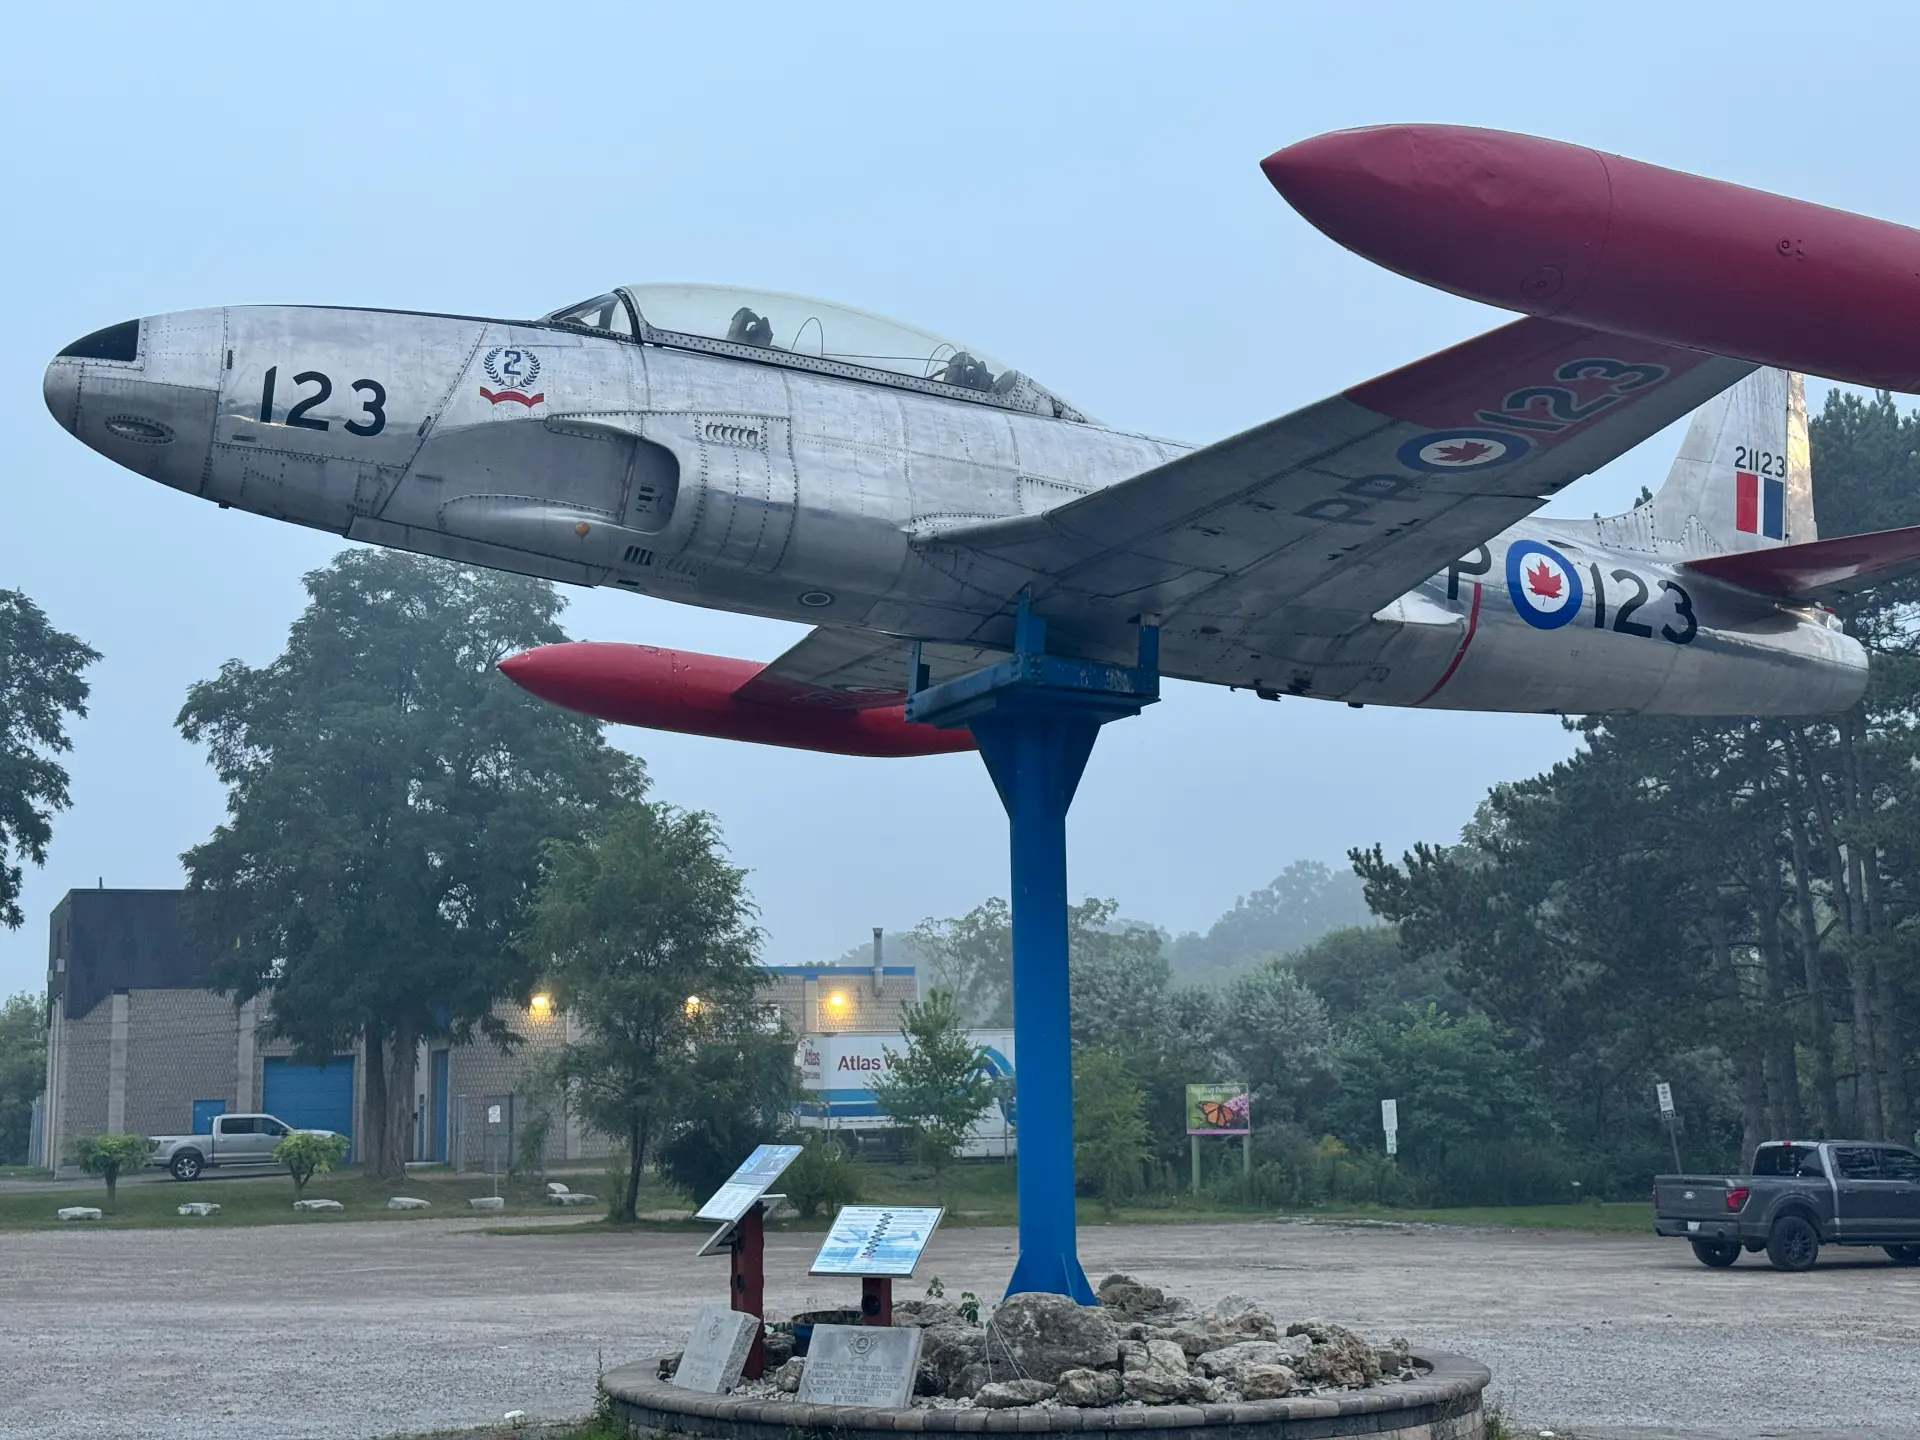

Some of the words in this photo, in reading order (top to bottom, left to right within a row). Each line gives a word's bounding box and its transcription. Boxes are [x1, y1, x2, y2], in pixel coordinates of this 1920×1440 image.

[504, 350, 521, 375] 2
[260, 366, 386, 437] 123
[1474, 357, 1671, 432] 123
[1734, 445, 1785, 478] 21123
[1590, 562, 1697, 644] 123
[803, 1048, 820, 1066] Atlas
[838, 1055, 881, 1071] Atlas
